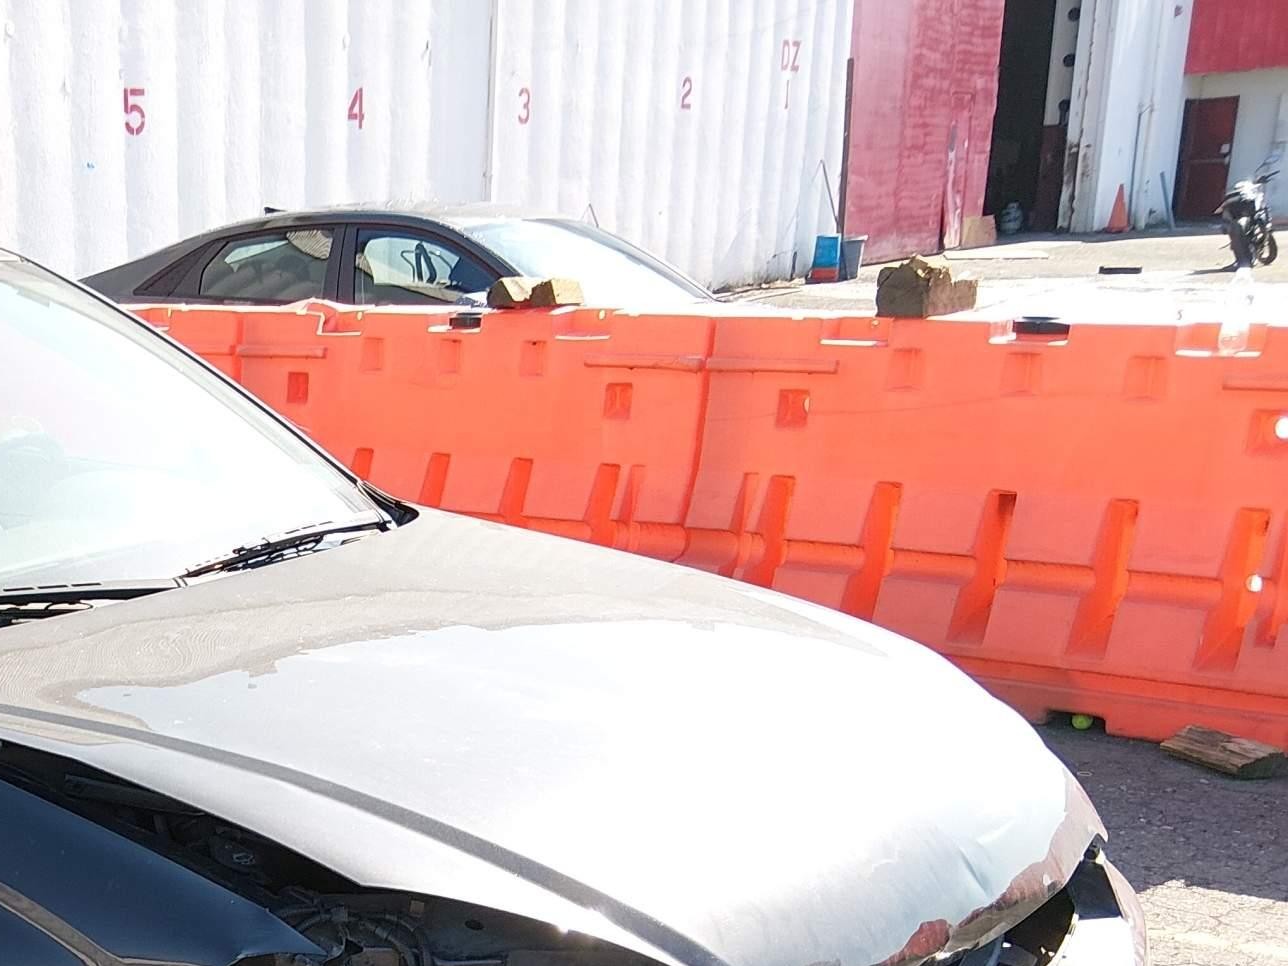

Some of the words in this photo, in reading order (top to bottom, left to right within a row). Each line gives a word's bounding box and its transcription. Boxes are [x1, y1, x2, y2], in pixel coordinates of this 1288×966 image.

[124, 87, 146, 136] 5
[347, 87, 365, 129] 4
[519, 87, 531, 124] 3
[680, 77, 693, 111] 2
